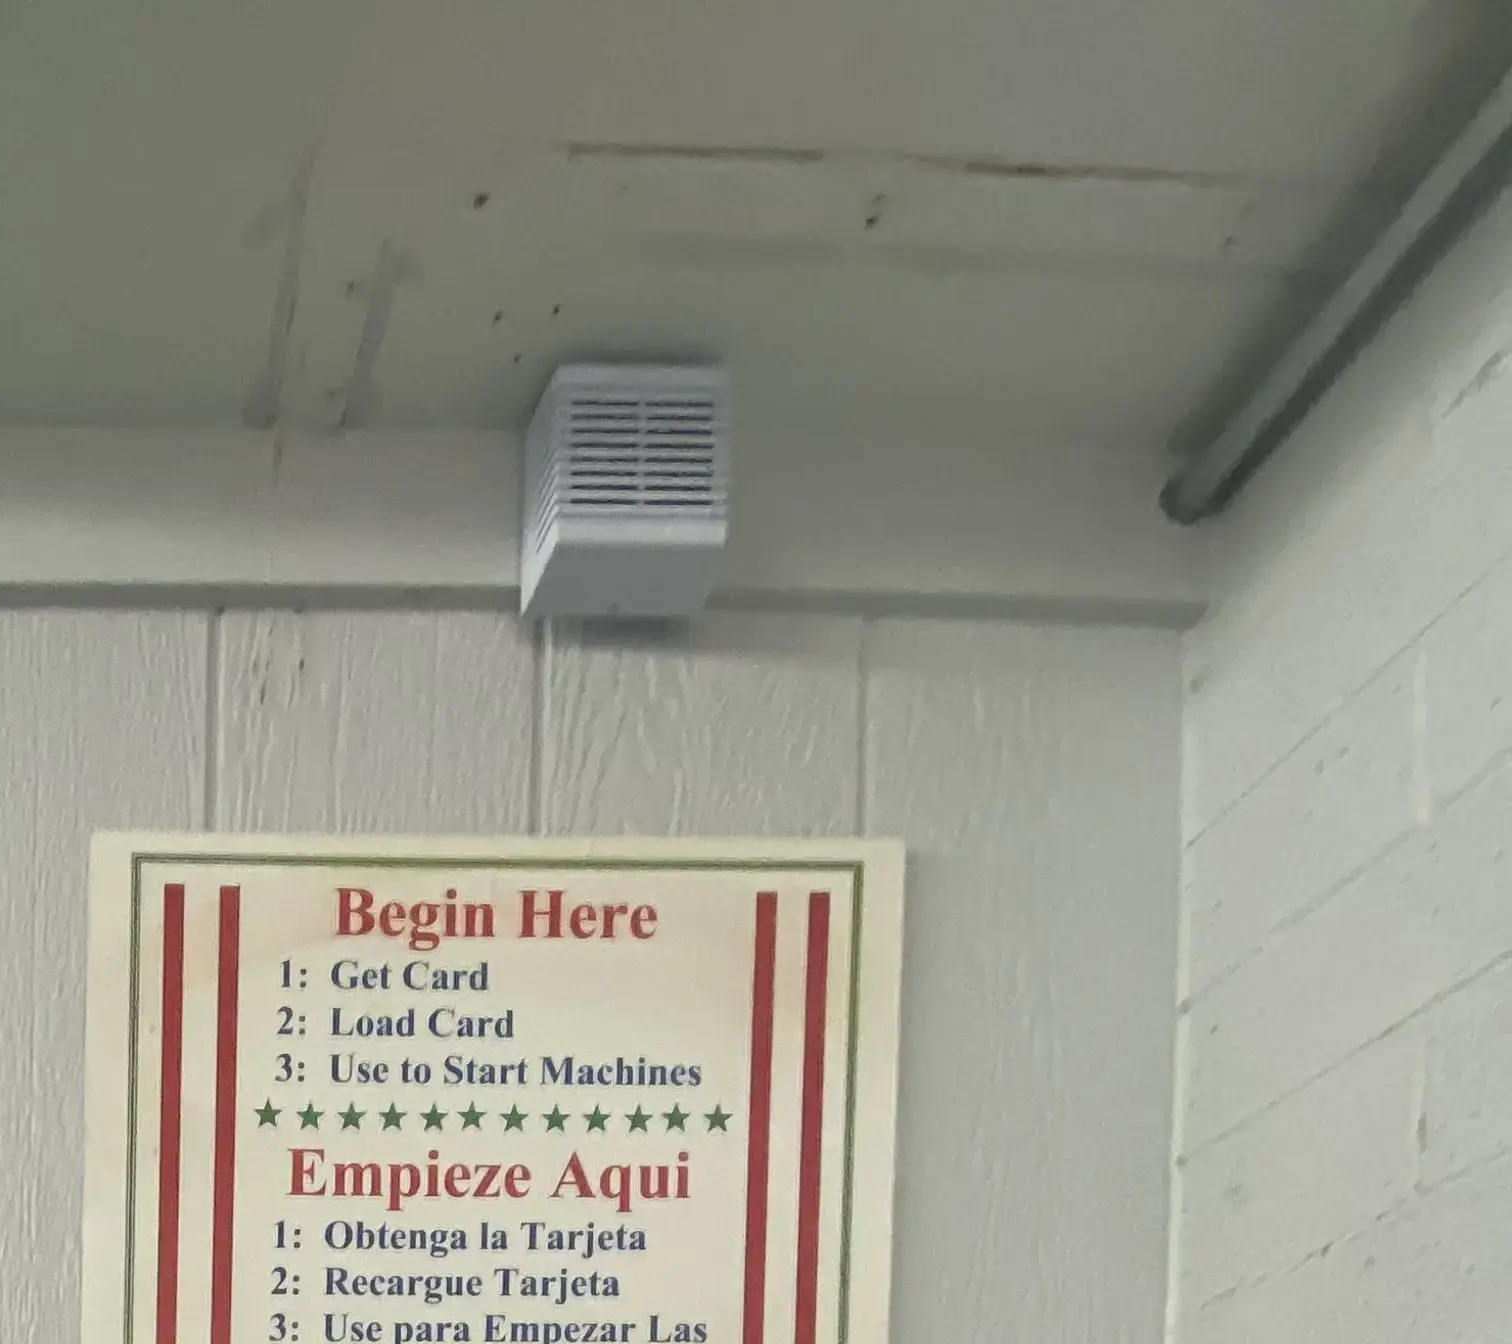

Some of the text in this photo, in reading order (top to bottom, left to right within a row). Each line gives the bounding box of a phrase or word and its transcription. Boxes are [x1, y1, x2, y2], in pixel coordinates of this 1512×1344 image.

[335, 886, 658, 951] Begin Here
[279, 959, 489, 991] 1: Get Card
[276, 1007, 515, 1039] 2: Load Card
[274, 1053, 703, 1088] 3: Use to Start Machines
[286, 1147, 692, 1213] Empieze Aqui
[272, 1220, 647, 1259] 1: Obtenga la Tarjeta
[270, 1266, 621, 1305] 2: Recargue Tarjeta
[268, 1313, 299, 1343] 3:
[324, 1313, 383, 1344] Use
[647, 1315, 708, 1344] Las
